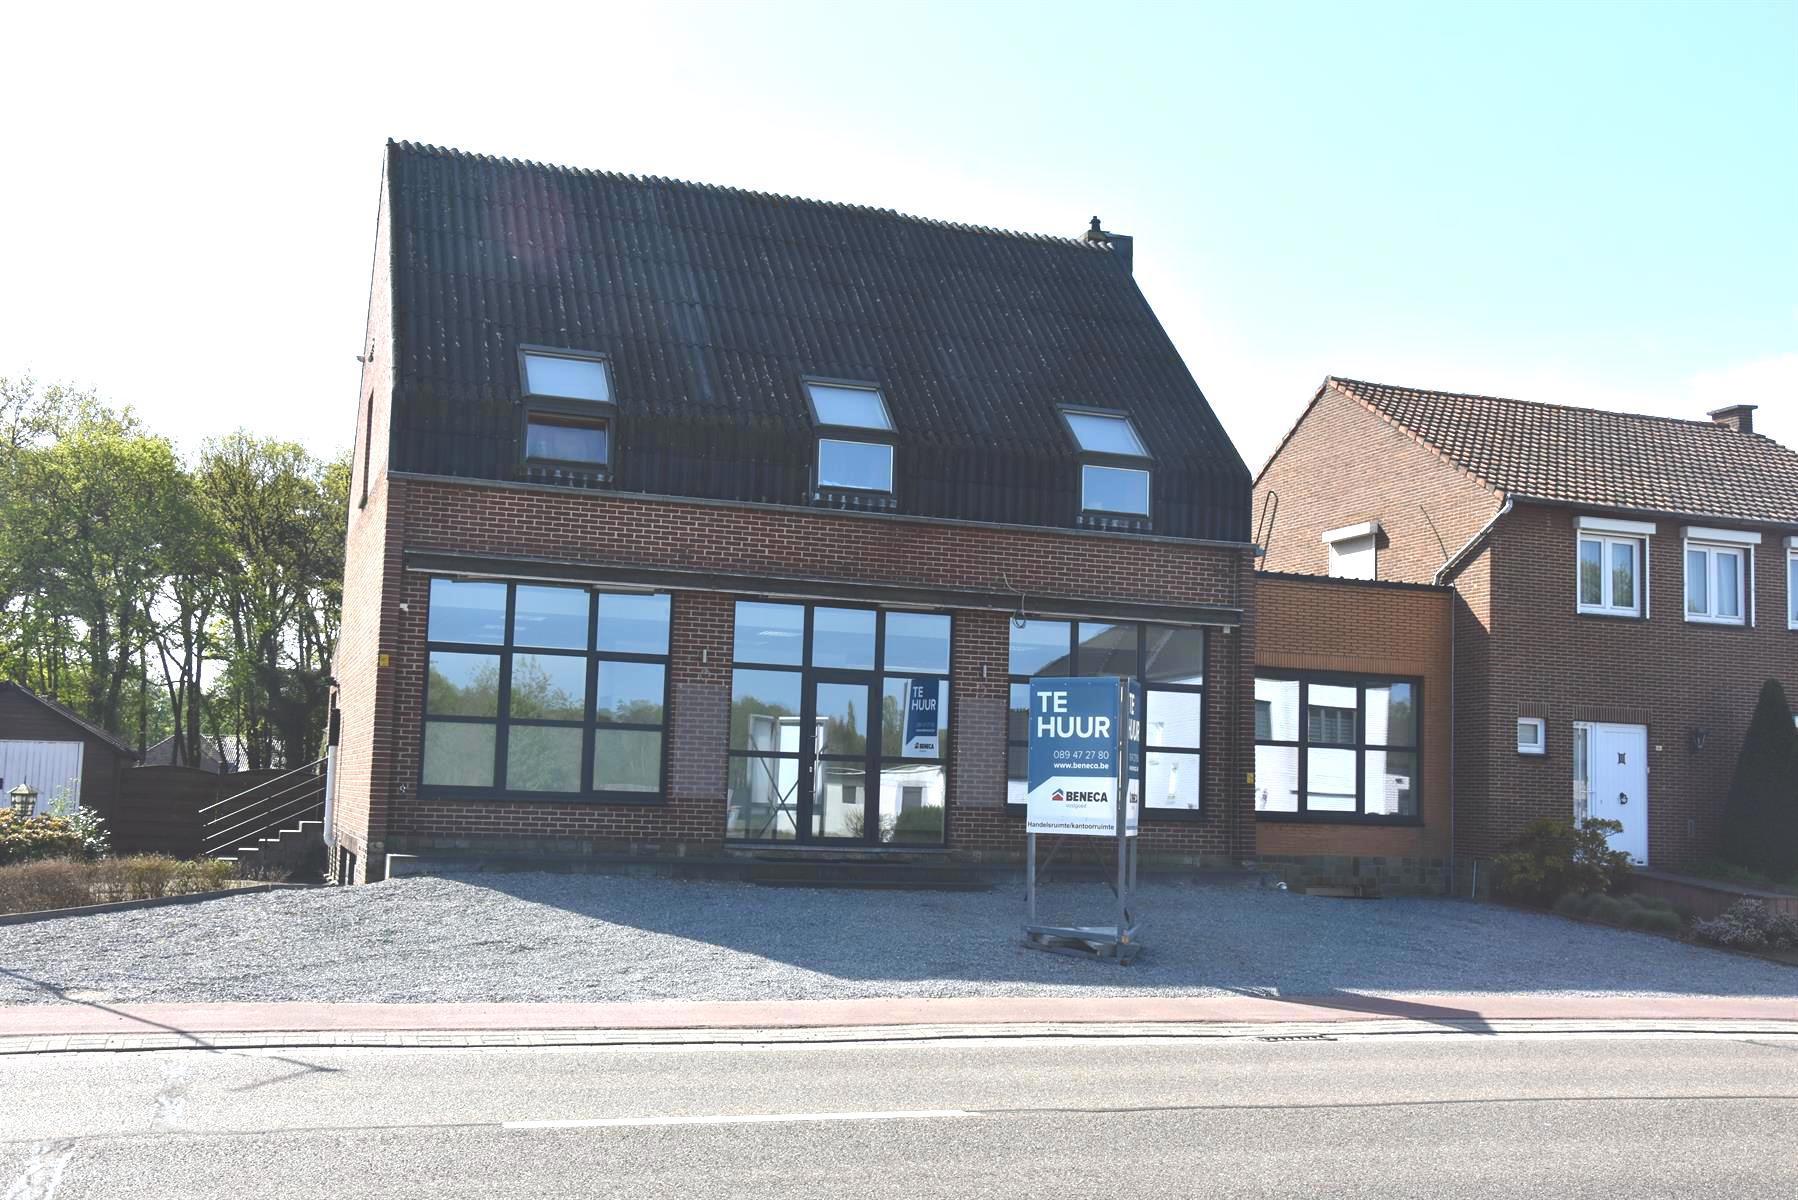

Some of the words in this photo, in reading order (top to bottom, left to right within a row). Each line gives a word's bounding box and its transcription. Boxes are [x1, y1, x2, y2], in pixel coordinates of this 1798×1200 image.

[912, 686, 924, 698] TE
[911, 699, 936, 711] HUUR
[1037, 691, 1068, 713] TE
[1037, 716, 1110, 738] HUUR
[1053, 750, 1070, 760] 089
[1072, 750, 1083, 760] 47
[1085, 751, 1096, 760] 27
[1098, 750, 1110, 760] 80
[1053, 762, 1109, 770] www.beneca.be
[1065, 791, 1108, 803] BENECA
